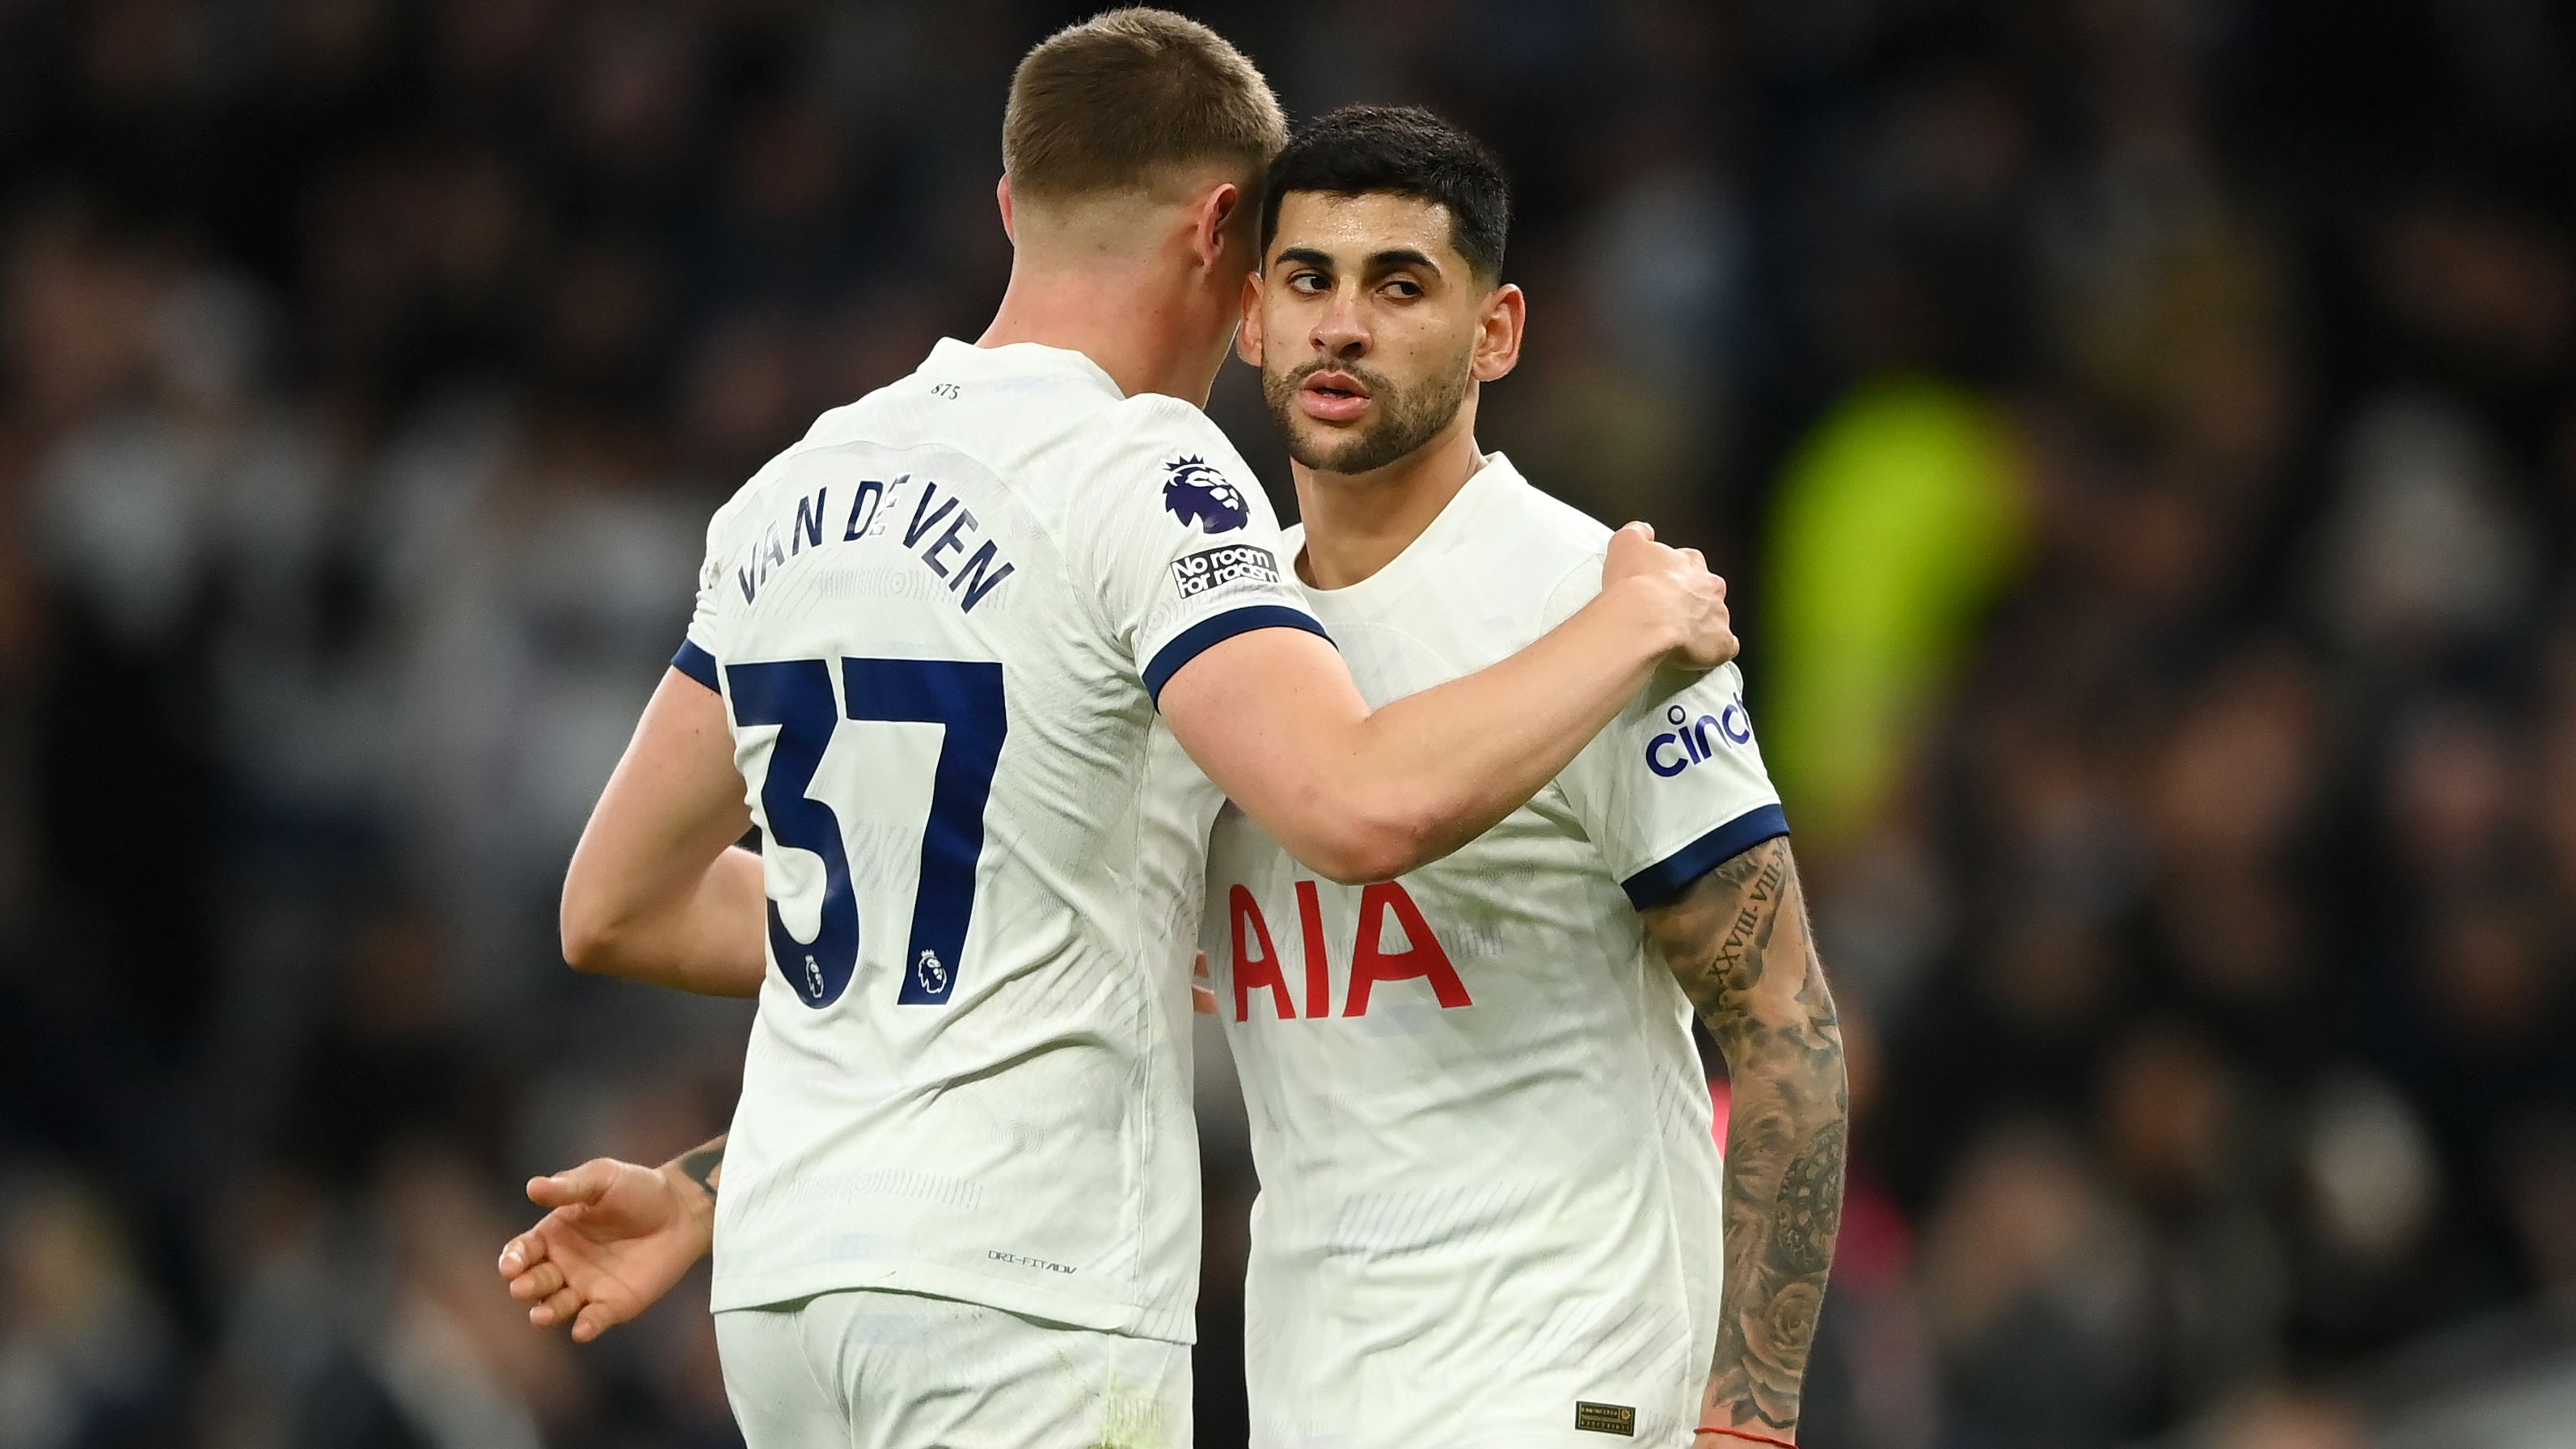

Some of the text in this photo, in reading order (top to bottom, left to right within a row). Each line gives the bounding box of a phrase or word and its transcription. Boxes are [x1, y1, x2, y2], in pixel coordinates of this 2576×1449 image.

[931, 383, 961, 400] 875
[737, 474, 1016, 614] VAN DE VEN
[1171, 547, 1269, 581] No room
[1176, 563, 1281, 598] for racism
[724, 656, 1008, 1010] 37
[1229, 880, 1473, 1023] AIA
